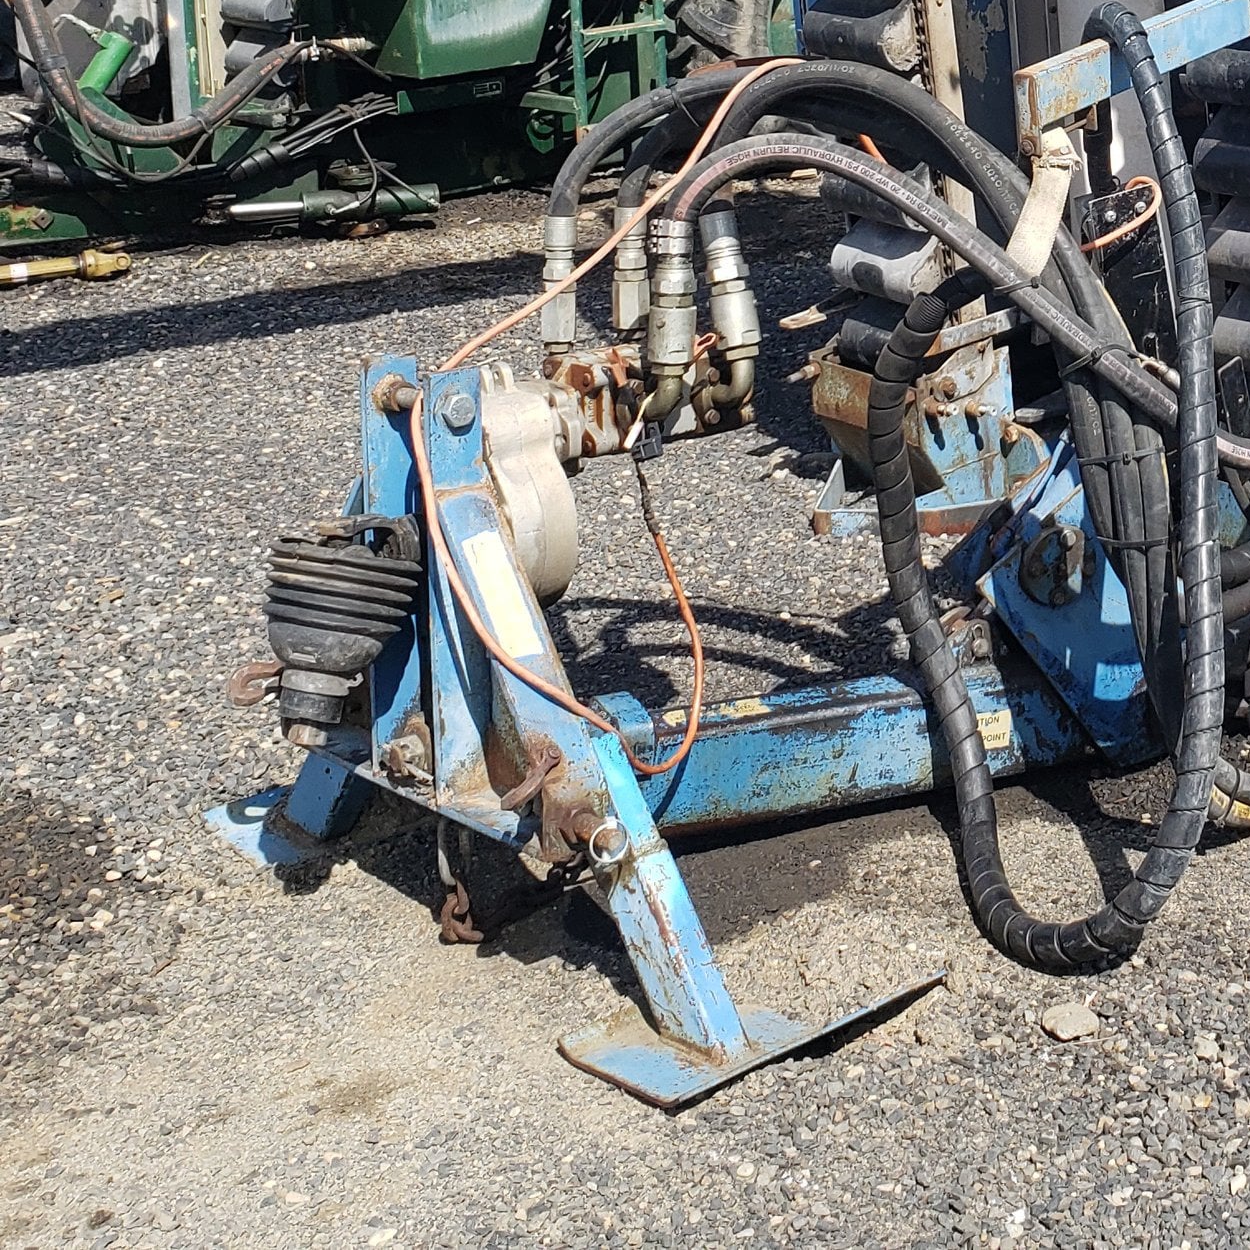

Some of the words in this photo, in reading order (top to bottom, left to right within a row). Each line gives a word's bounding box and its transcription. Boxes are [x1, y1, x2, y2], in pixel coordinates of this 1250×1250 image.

[752, 145, 791, 157] RETURN
[791, 146, 844, 166] HYDRAULIC
[726, 151, 752, 166] HOSE
[845, 159, 860, 172] PSI
[860, 167, 876, 179] 200
[875, 175, 890, 189] WP
[890, 184, 901, 196] 20
[979, 716, 1001, 727] TION
